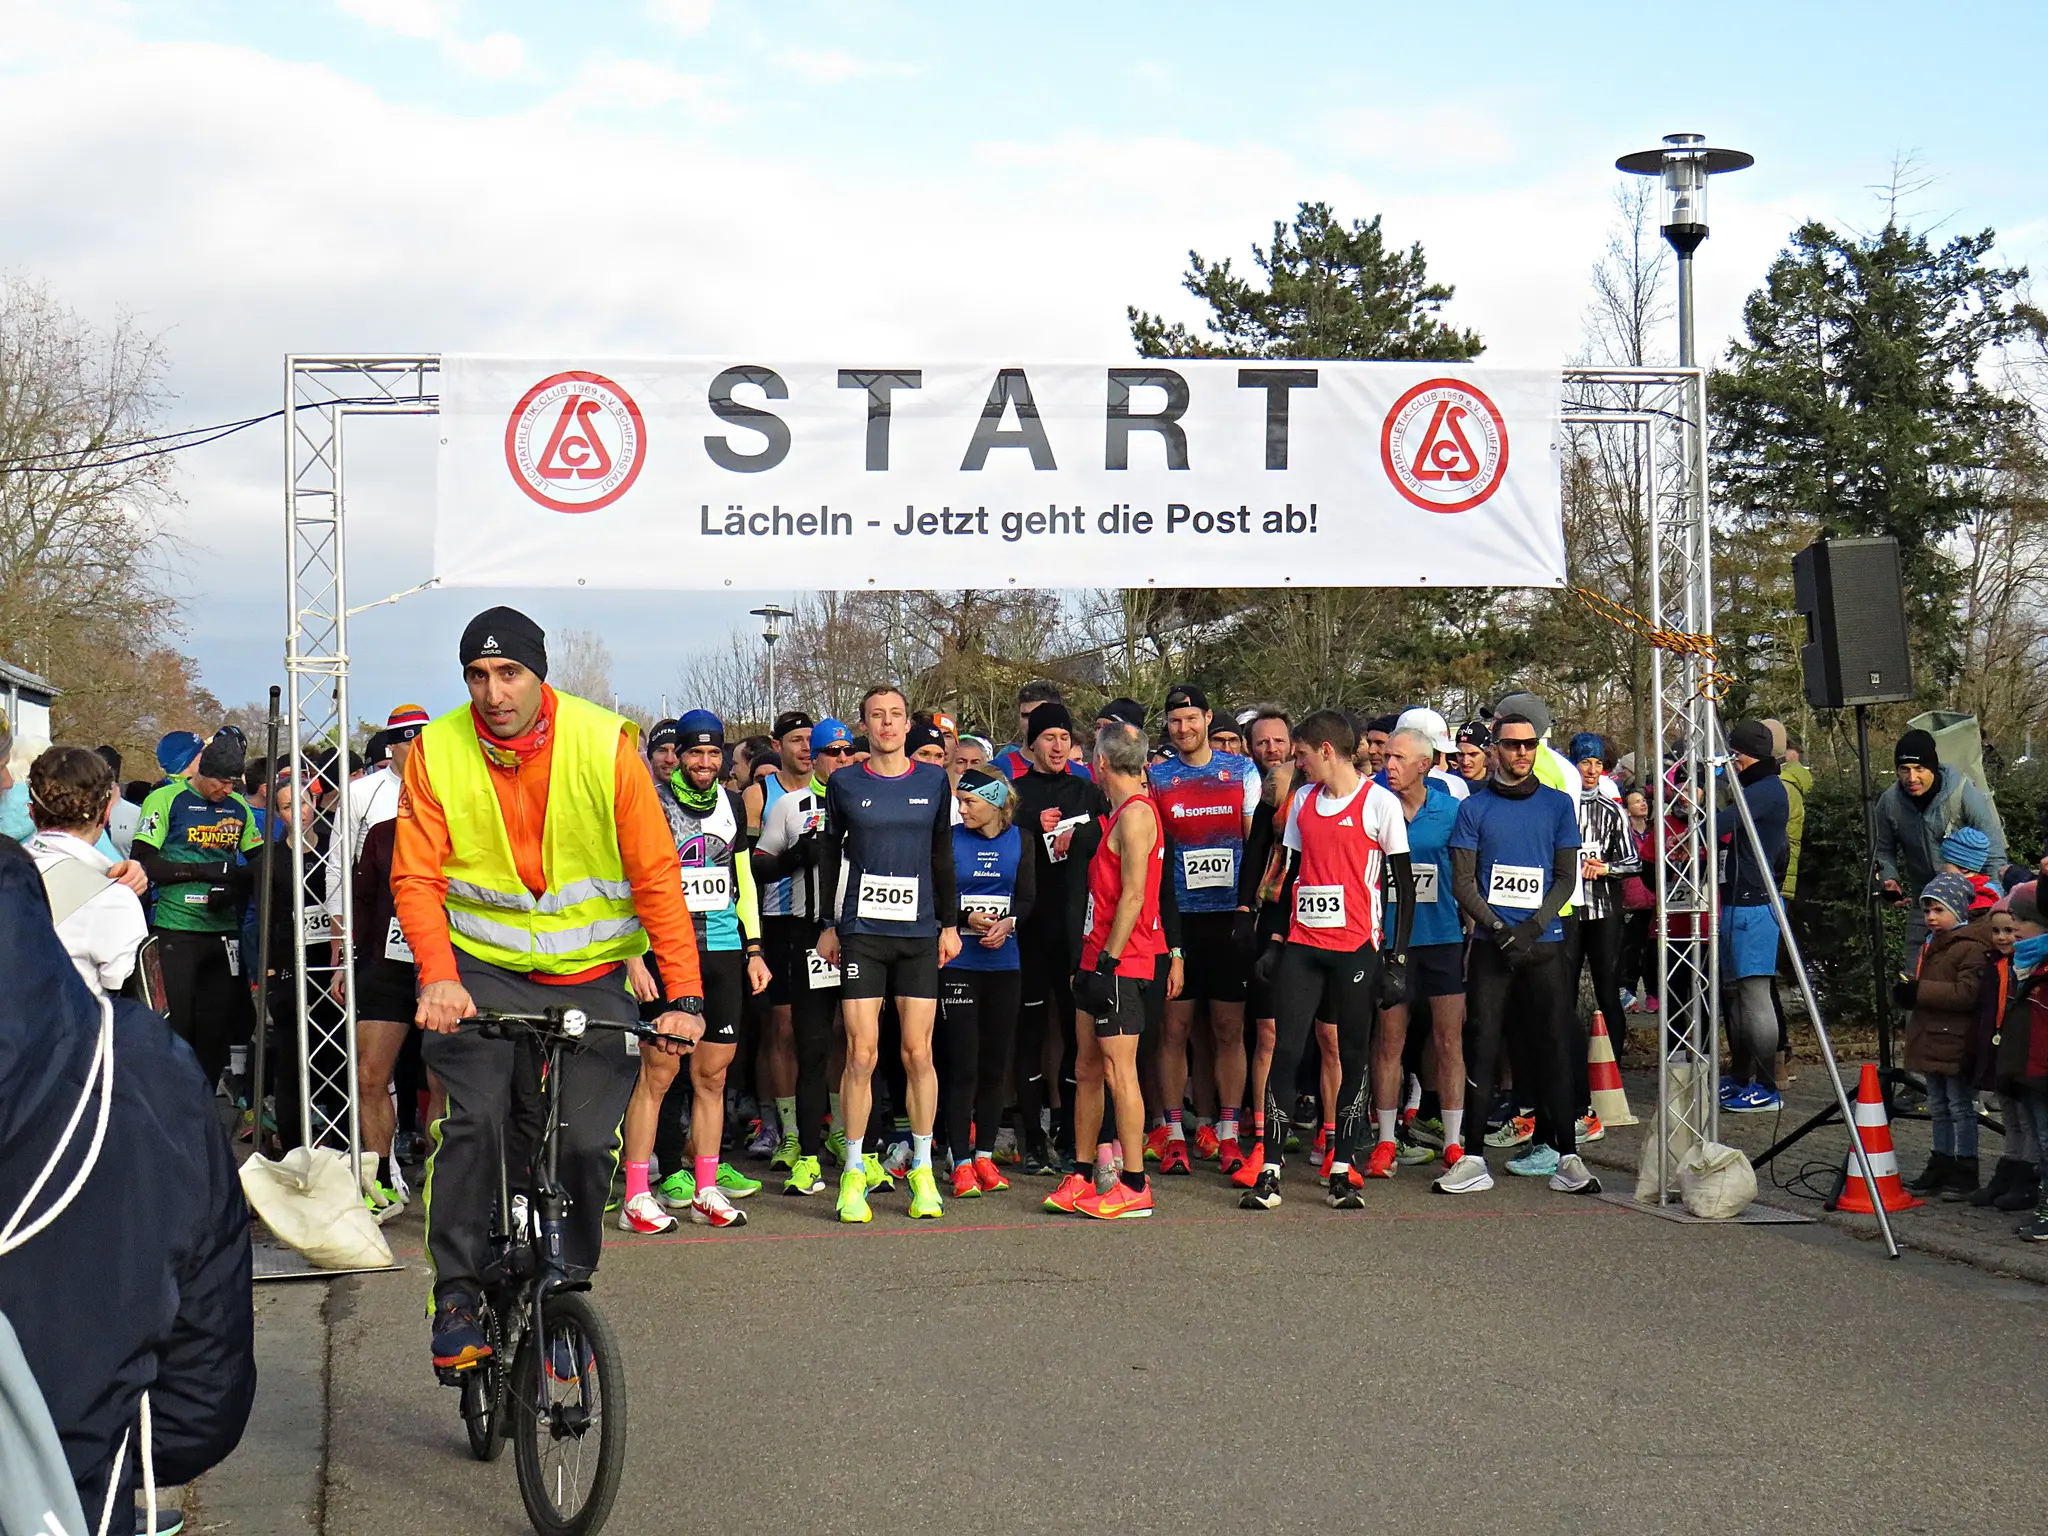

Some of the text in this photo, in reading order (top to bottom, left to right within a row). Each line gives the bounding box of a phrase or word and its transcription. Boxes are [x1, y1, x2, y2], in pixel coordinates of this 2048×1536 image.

[704, 365, 1318, 473] START
[517, 385, 568, 491] LEICHTATHLETIK-CLUB
[572, 384, 598, 396] 1969
[601, 407, 635, 493] SCHIFFERSTADT
[1392, 392, 1438, 493] LEICHTATHLETIK-CLUB
[1442, 391, 1464, 401] 1969
[1470, 413, 1498, 494] SCHIFFERSTADT
[701, 505, 853, 536] Lächeln
[893, 505, 989, 536] Jetzt
[1001, 504, 1085, 542] geht
[1097, 504, 1154, 534] die
[1167, 504, 1251, 534] Post
[1262, 504, 1317, 534] ab!
[1185, 806, 1233, 817] SOPREMA
[1187, 858, 1231, 875] 2407
[681, 878, 726, 896] 2100
[1493, 875, 1540, 893] 2409
[862, 886, 914, 904] 2505
[1298, 897, 1340, 912] 2193
